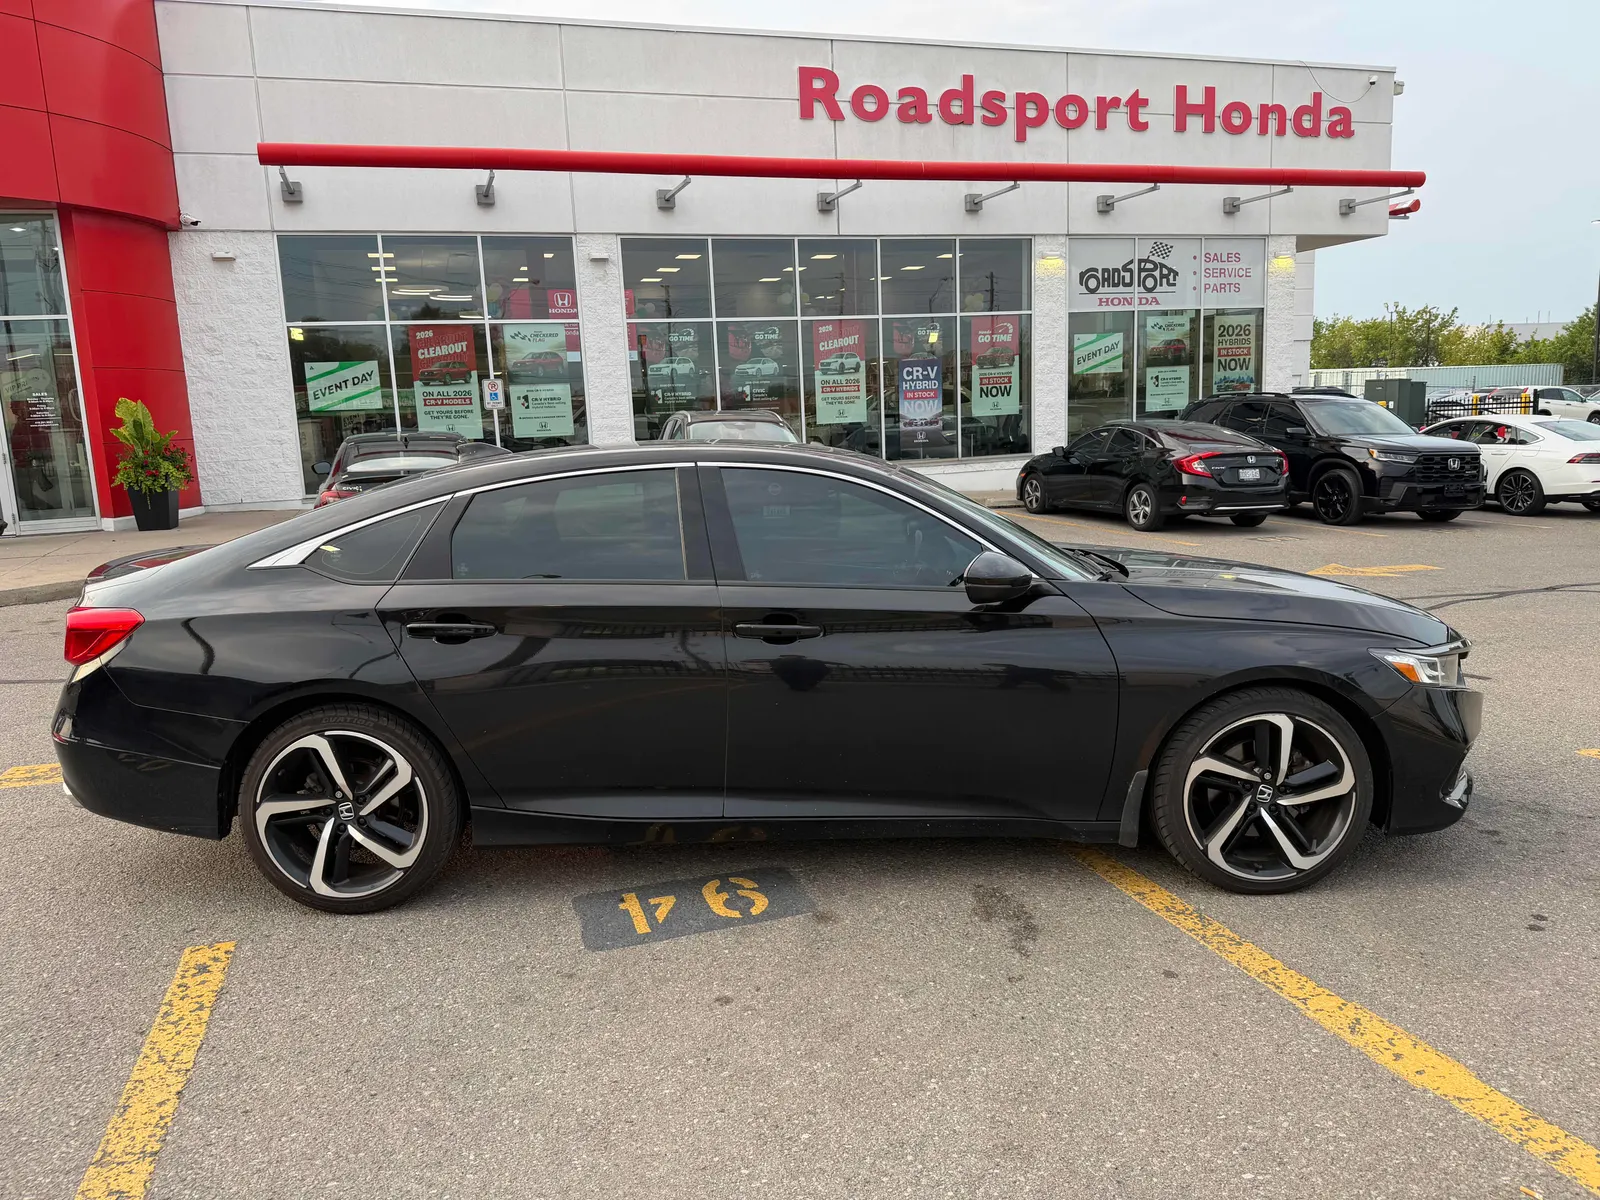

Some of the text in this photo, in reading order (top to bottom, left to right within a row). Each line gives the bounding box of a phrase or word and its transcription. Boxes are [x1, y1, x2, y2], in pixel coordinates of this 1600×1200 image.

[798, 66, 1355, 142] Roadsport Honda
[1203, 252, 1241, 263] SALES
[1203, 267, 1252, 279] SERVICE
[1203, 282, 1241, 294] PARTS
[1097, 296, 1161, 307] HONDA
[415, 330, 434, 339] 2026
[1217, 324, 1252, 338] 2026
[819, 335, 860, 351] CLEAROUT
[978, 334, 1012, 343] GO TIME
[1217, 338, 1252, 346] HYBRIDS
[417, 342, 468, 359] CLEAROUT
[1077, 340, 1120, 366] EVENT DAY
[1217, 358, 1251, 372] NOW
[902, 366, 938, 380] CR-V
[312, 380, 350, 401] EVENT
[352, 369, 374, 386] DAY
[902, 380, 939, 390] HYBRID
[979, 385, 1012, 398] NOW
[904, 400, 938, 414] NOW
[320, 716, 375, 728] OVATION
